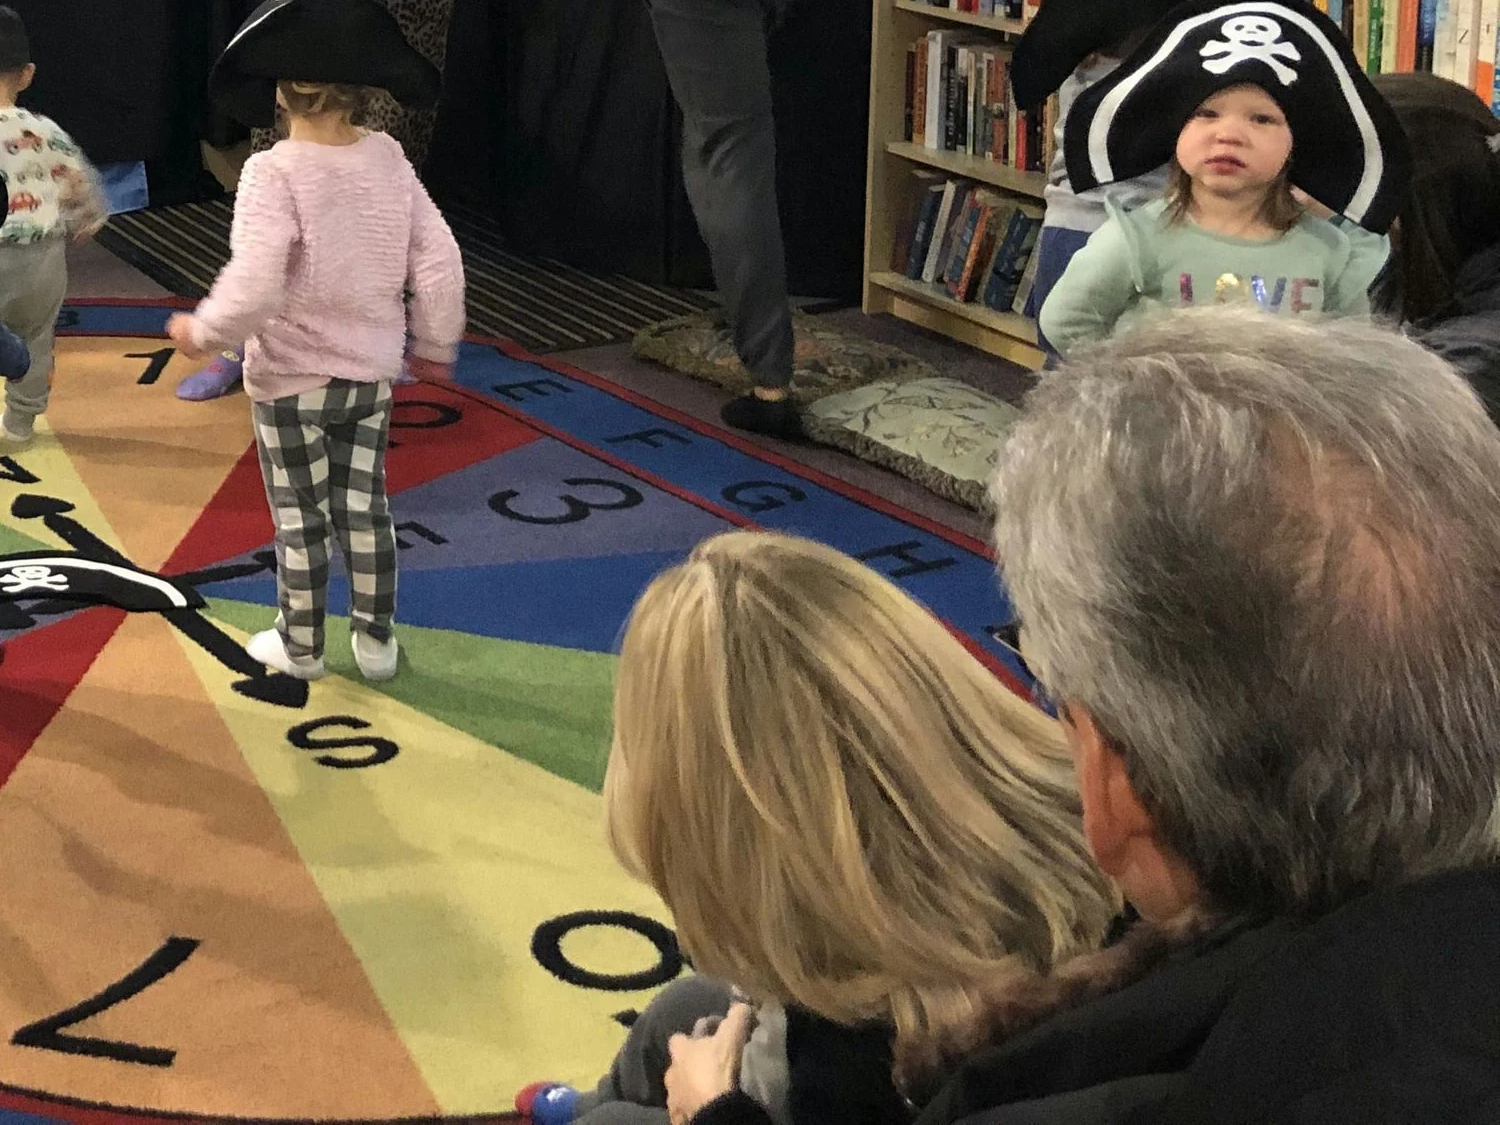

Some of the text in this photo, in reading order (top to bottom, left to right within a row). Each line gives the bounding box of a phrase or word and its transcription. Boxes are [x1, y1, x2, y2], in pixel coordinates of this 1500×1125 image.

[124, 347, 175, 385] 1
[492, 377, 574, 402] E
[604, 427, 693, 452] F
[487, 477, 644, 526] 3
[719, 480, 807, 513] G
[857, 540, 956, 578] H
[286, 714, 400, 769] S
[8, 935, 202, 1067] 7
